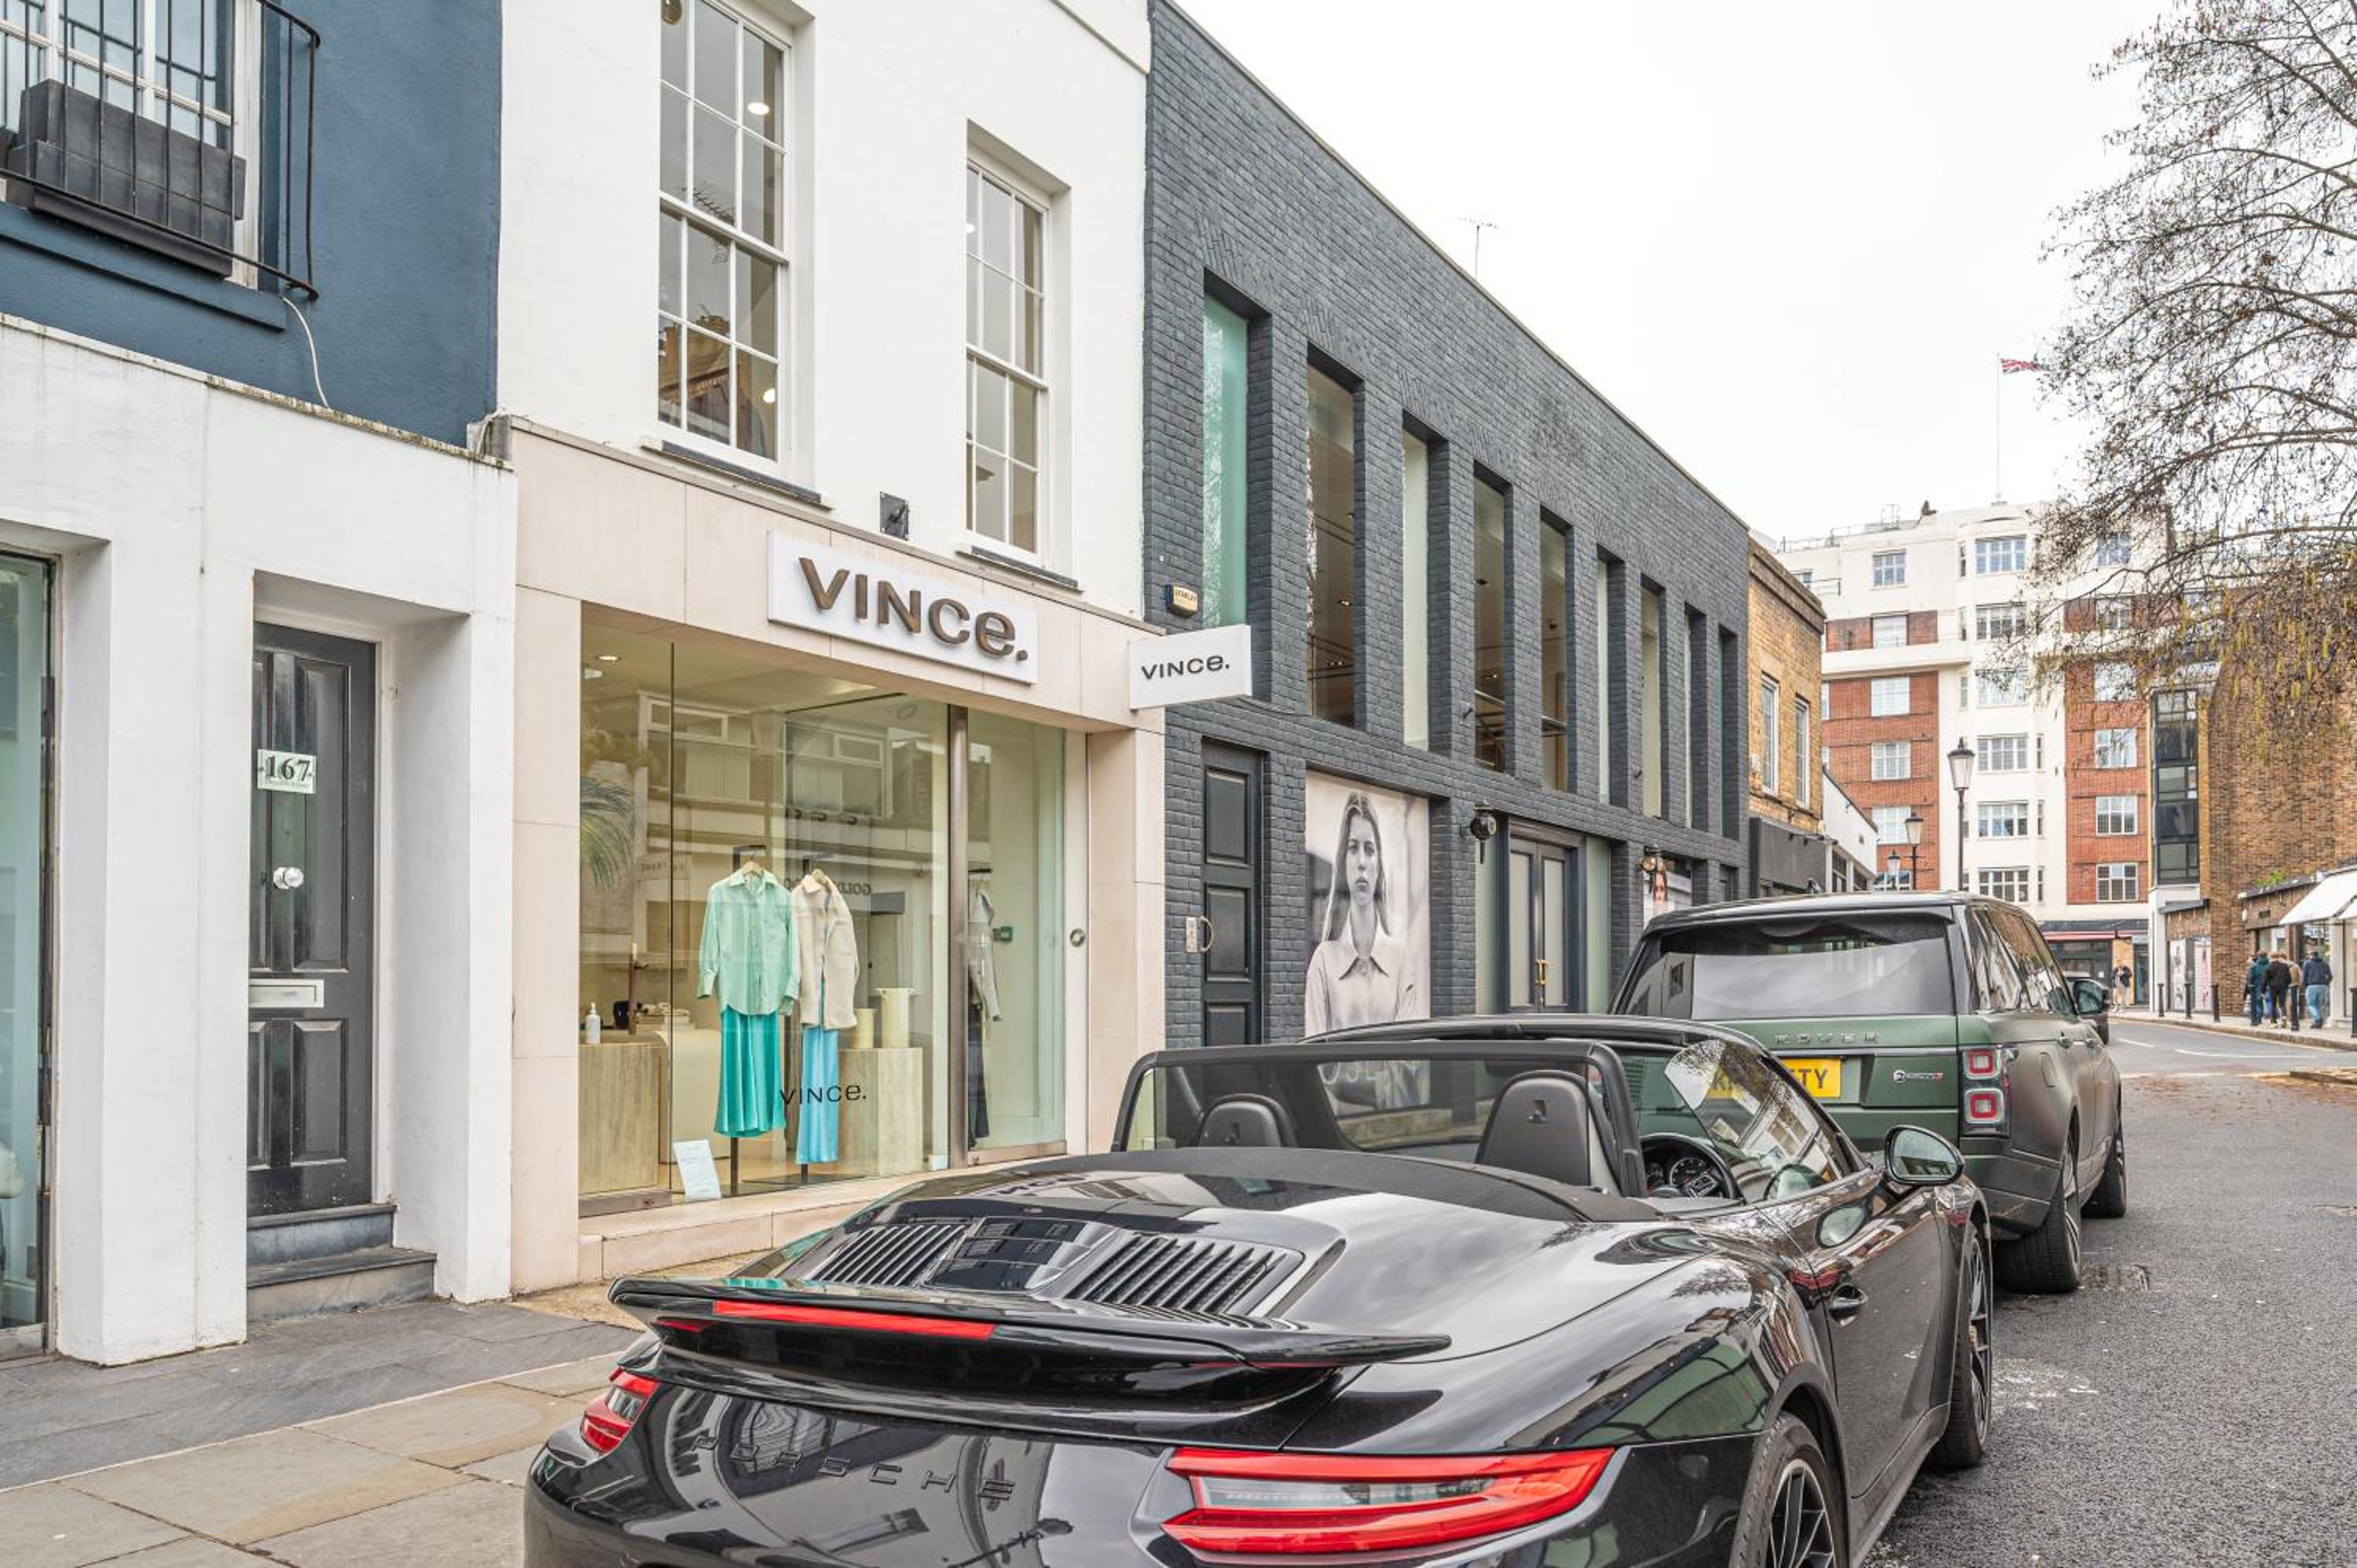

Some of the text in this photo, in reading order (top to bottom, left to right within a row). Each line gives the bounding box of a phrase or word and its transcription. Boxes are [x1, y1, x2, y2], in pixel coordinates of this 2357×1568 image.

[266, 756, 310, 782] 167
[1776, 1031, 1879, 1044] ROVER
[691, 1435, 1016, 1501] PORSCHE
